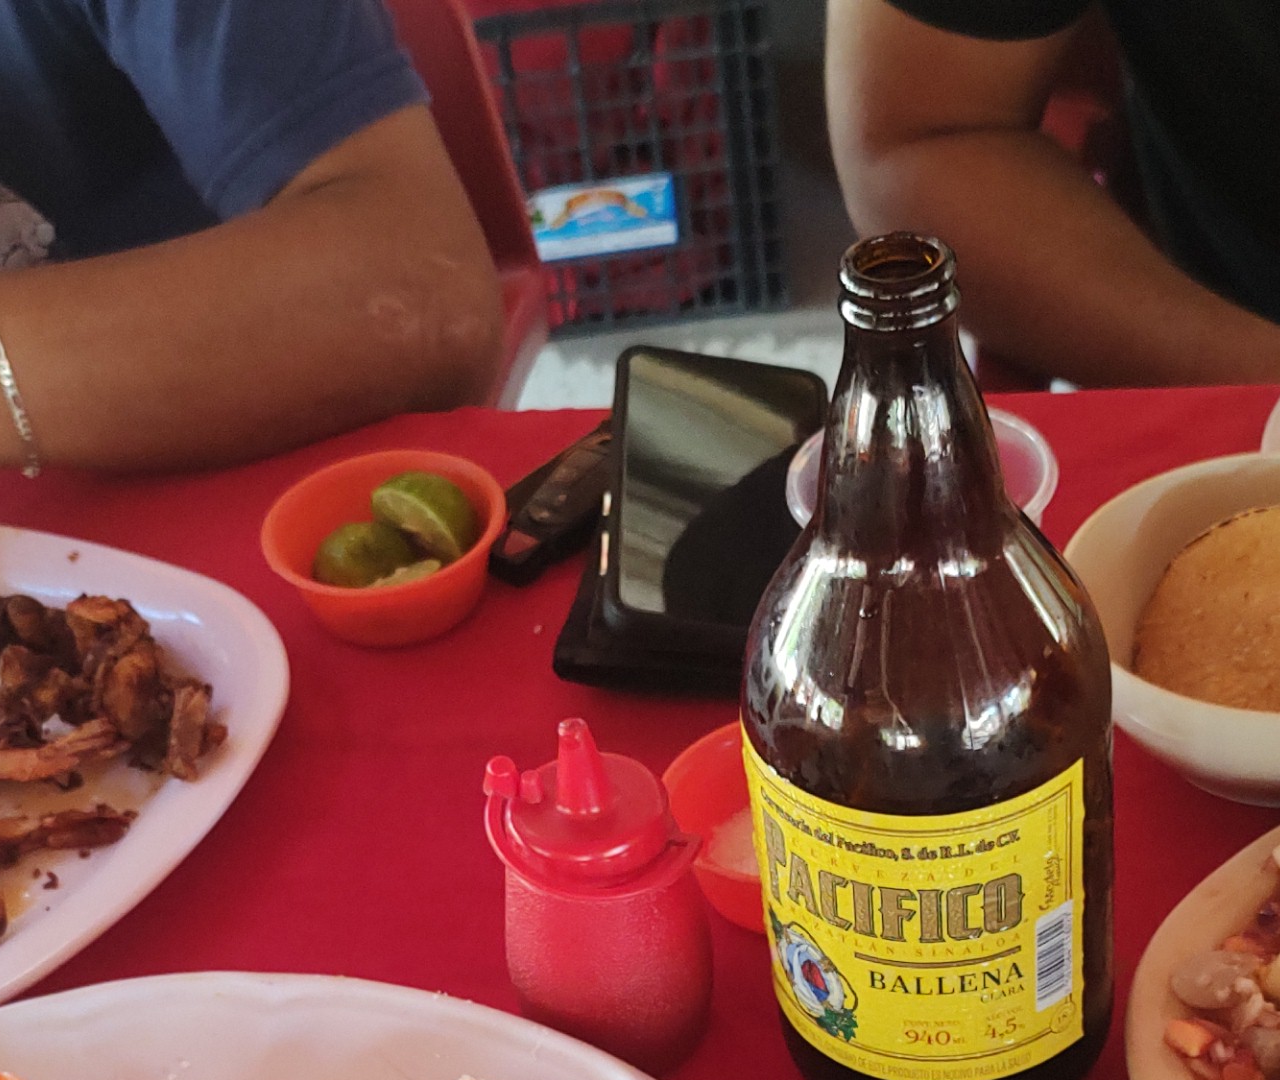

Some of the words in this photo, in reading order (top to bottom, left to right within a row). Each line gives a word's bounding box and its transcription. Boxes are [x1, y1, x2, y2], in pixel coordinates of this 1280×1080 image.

[917, 846, 937, 860] de
[975, 838, 995, 854] de
[762, 808, 1025, 944] PACIFICO
[964, 855, 1020, 878] DEL
[869, 961, 1025, 996] BALLENA
[980, 983, 1026, 1004] CLARA
[905, 1029, 951, 1046] 940
